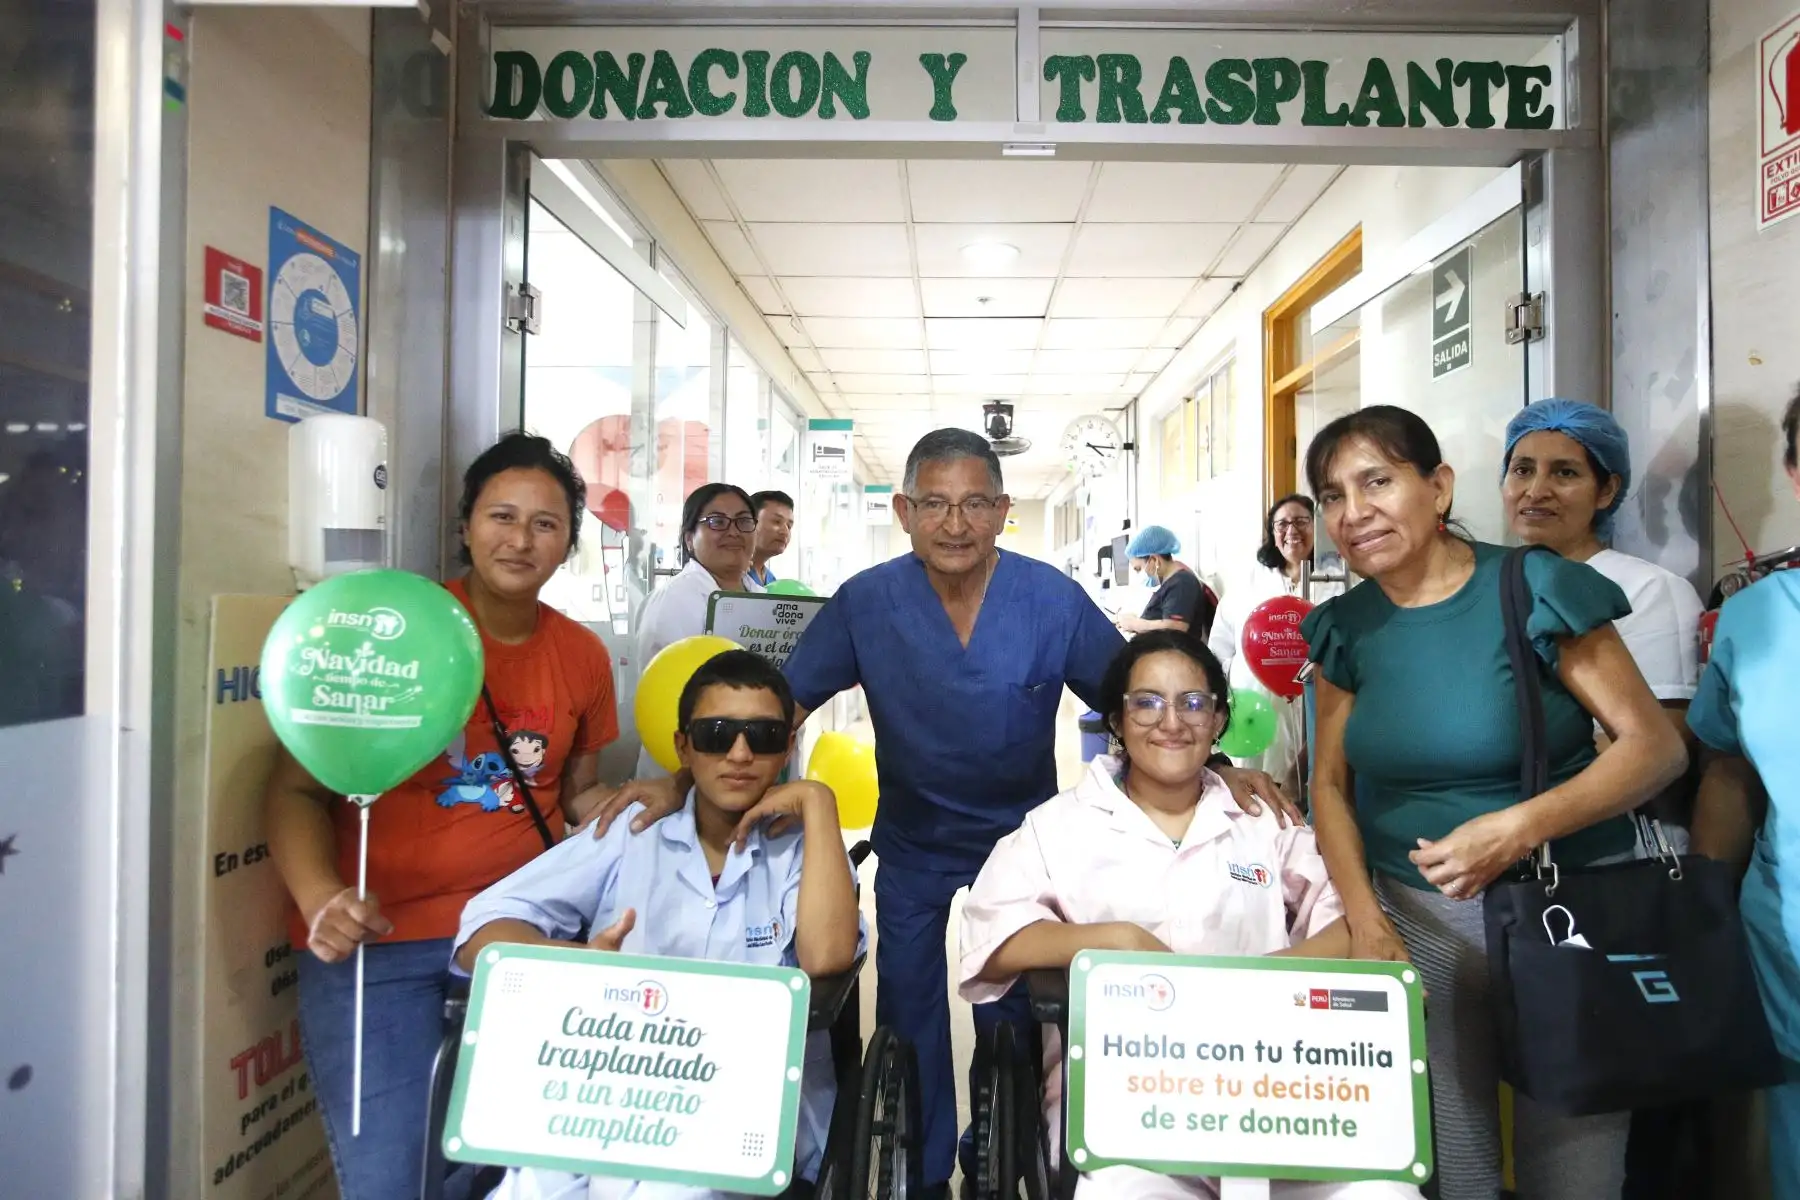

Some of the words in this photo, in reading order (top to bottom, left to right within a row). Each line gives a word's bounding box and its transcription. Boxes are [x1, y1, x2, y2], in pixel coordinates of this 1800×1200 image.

[488, 48, 871, 121] DONACION
[918, 52, 968, 121] Y
[1043, 53, 1555, 130] TRASPLANTE
[1767, 149, 1800, 179] EXTI
[1434, 340, 1468, 367] SALIDA
[327, 608, 373, 627] insn
[776, 603, 798, 611] ama
[777, 610, 804, 619] dona
[739, 624, 780, 639] Donar
[775, 618, 797, 626] vive
[750, 643, 762, 654] es
[765, 641, 777, 654] el
[1261, 629, 1304, 643] Navida
[298, 642, 419, 680] Navidad
[1270, 646, 1302, 657] Sanar
[312, 684, 395, 712] Sanar
[214, 851, 239, 877] En
[604, 982, 641, 1004] insn
[1103, 981, 1145, 998] insn
[562, 1006, 634, 1041] Cada
[639, 1016, 707, 1048] niño
[538, 1040, 721, 1083] trasplantado
[1103, 1033, 1186, 1060] Habla
[1196, 1042, 1244, 1063] con
[1254, 1040, 1283, 1064] tu
[1292, 1039, 1393, 1069] familia
[542, 1079, 568, 1101] es
[577, 1082, 613, 1106] un
[619, 1084, 706, 1115] sueño
[1127, 1069, 1204, 1096] sobre
[1215, 1073, 1243, 1098] tu
[1253, 1073, 1371, 1103] decisión
[240, 1093, 278, 1136] para
[281, 1075, 296, 1101] el
[547, 1111, 684, 1151] cumplido
[1141, 1104, 1176, 1130] de
[1186, 1111, 1229, 1132] ser
[1239, 1107, 1358, 1138] donante
